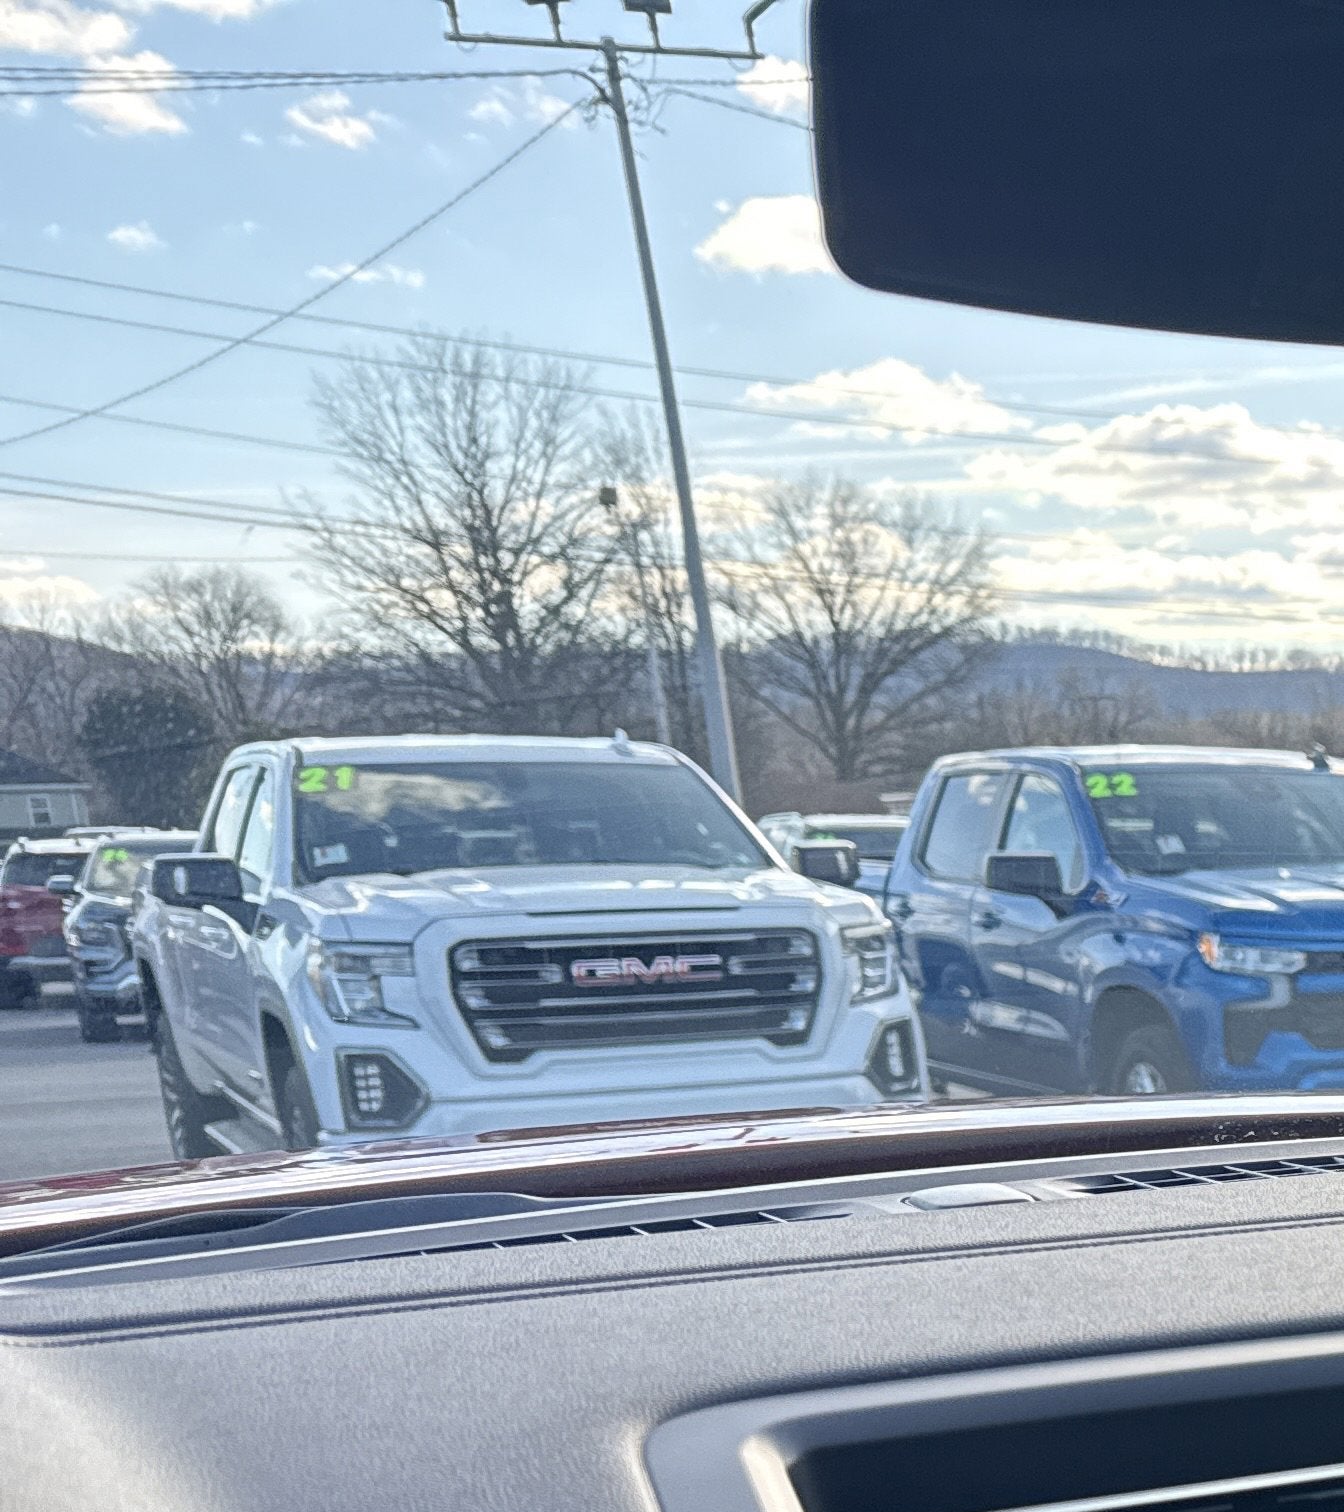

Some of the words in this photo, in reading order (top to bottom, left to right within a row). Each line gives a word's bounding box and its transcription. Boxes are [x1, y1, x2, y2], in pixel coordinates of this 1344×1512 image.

[299, 766, 354, 792] 21
[1085, 772, 1137, 798] 22
[570, 954, 723, 988] GMC
